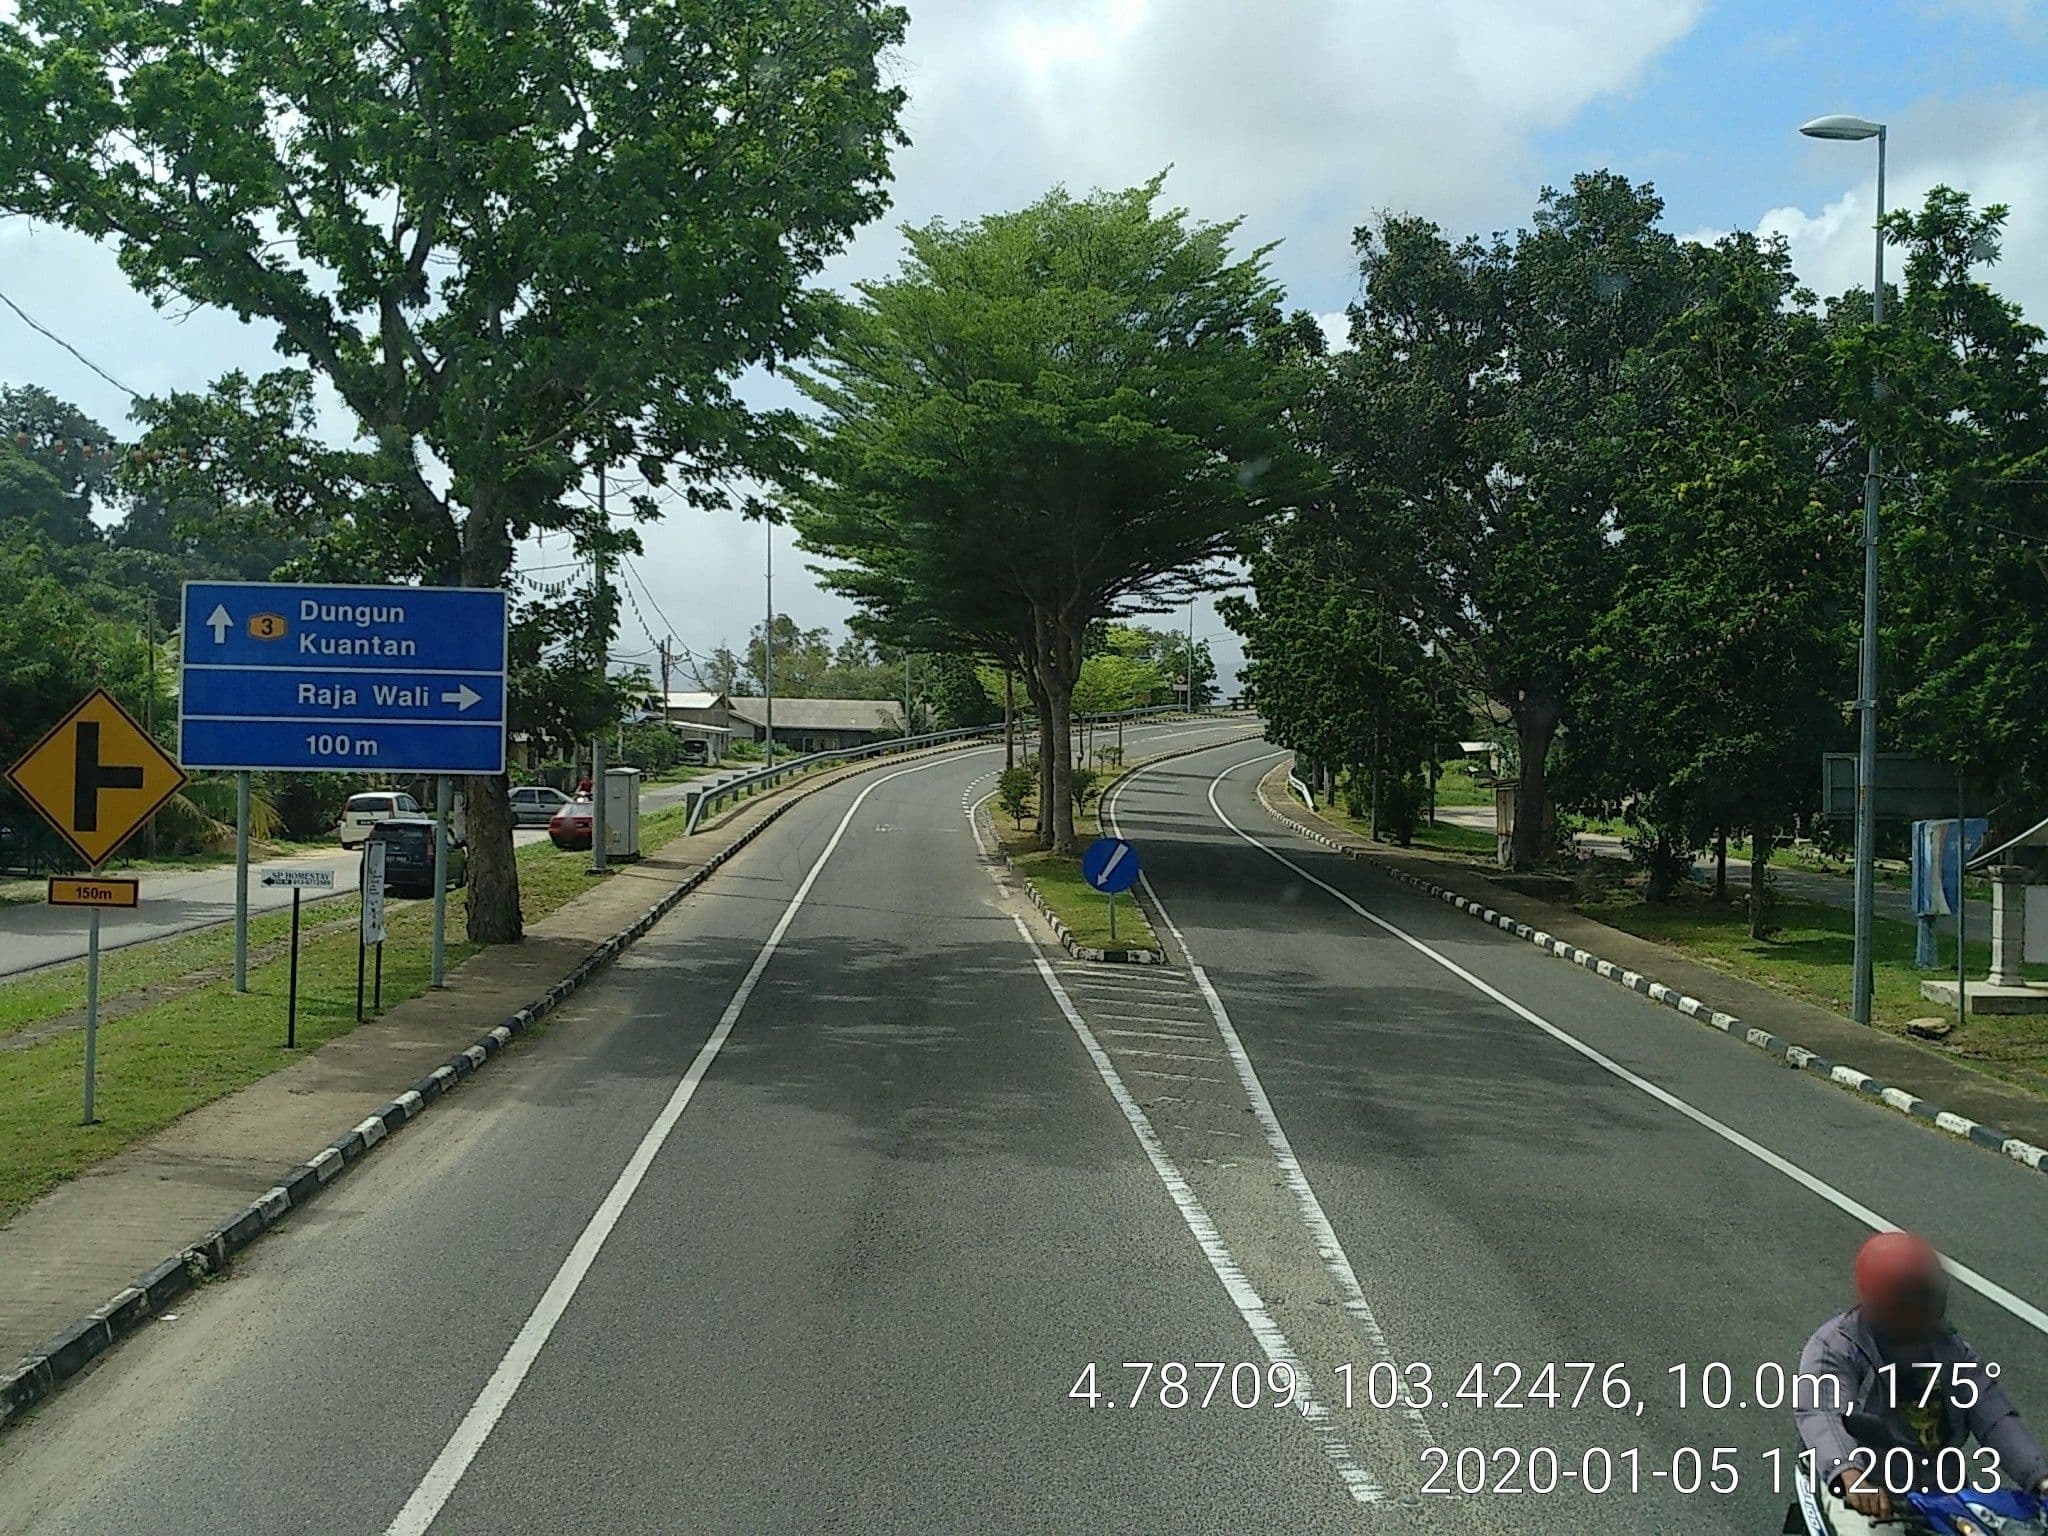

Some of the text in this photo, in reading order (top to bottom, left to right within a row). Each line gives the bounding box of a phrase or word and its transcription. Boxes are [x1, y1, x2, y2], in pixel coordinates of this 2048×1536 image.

[299, 599, 406, 630] Dungun
[260, 618, 273, 636] 3
[299, 633, 417, 657] Kuantan
[297, 683, 430, 710] Raja Wali
[285, 871, 330, 880] HOMESTAY
[75, 886, 113, 901] 150m
